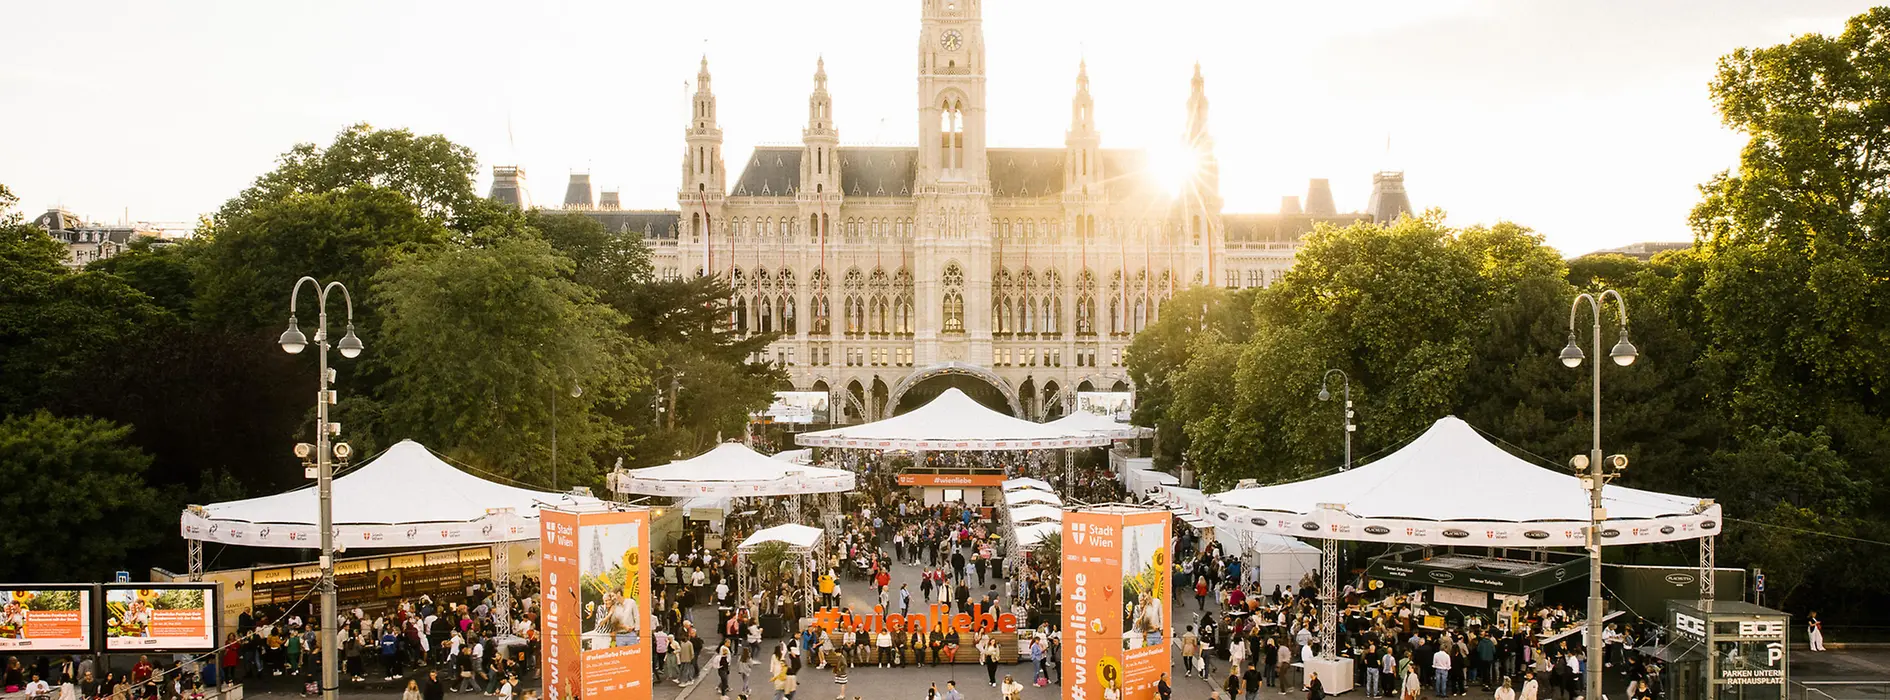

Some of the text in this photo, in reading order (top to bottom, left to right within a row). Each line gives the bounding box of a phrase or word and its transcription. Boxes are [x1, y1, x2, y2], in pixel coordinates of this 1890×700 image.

[557, 523, 573, 536] Stadt
[1089, 523, 1114, 536] Stadt
[557, 535, 574, 547] Wien
[1089, 536, 1114, 548] Wien
[265, 571, 280, 579] ZUM
[813, 603, 1017, 635] #wienliebe
[1676, 612, 1706, 637] BOE
[1739, 621, 1783, 635] BOE
[547, 572, 559, 700] #wienliebe
[1070, 572, 1087, 700] #wienliebe
[586, 648, 641, 660] #wienliebe Festival
[1768, 648, 1782, 667] P
[1753, 669, 1784, 677] UNTERM
